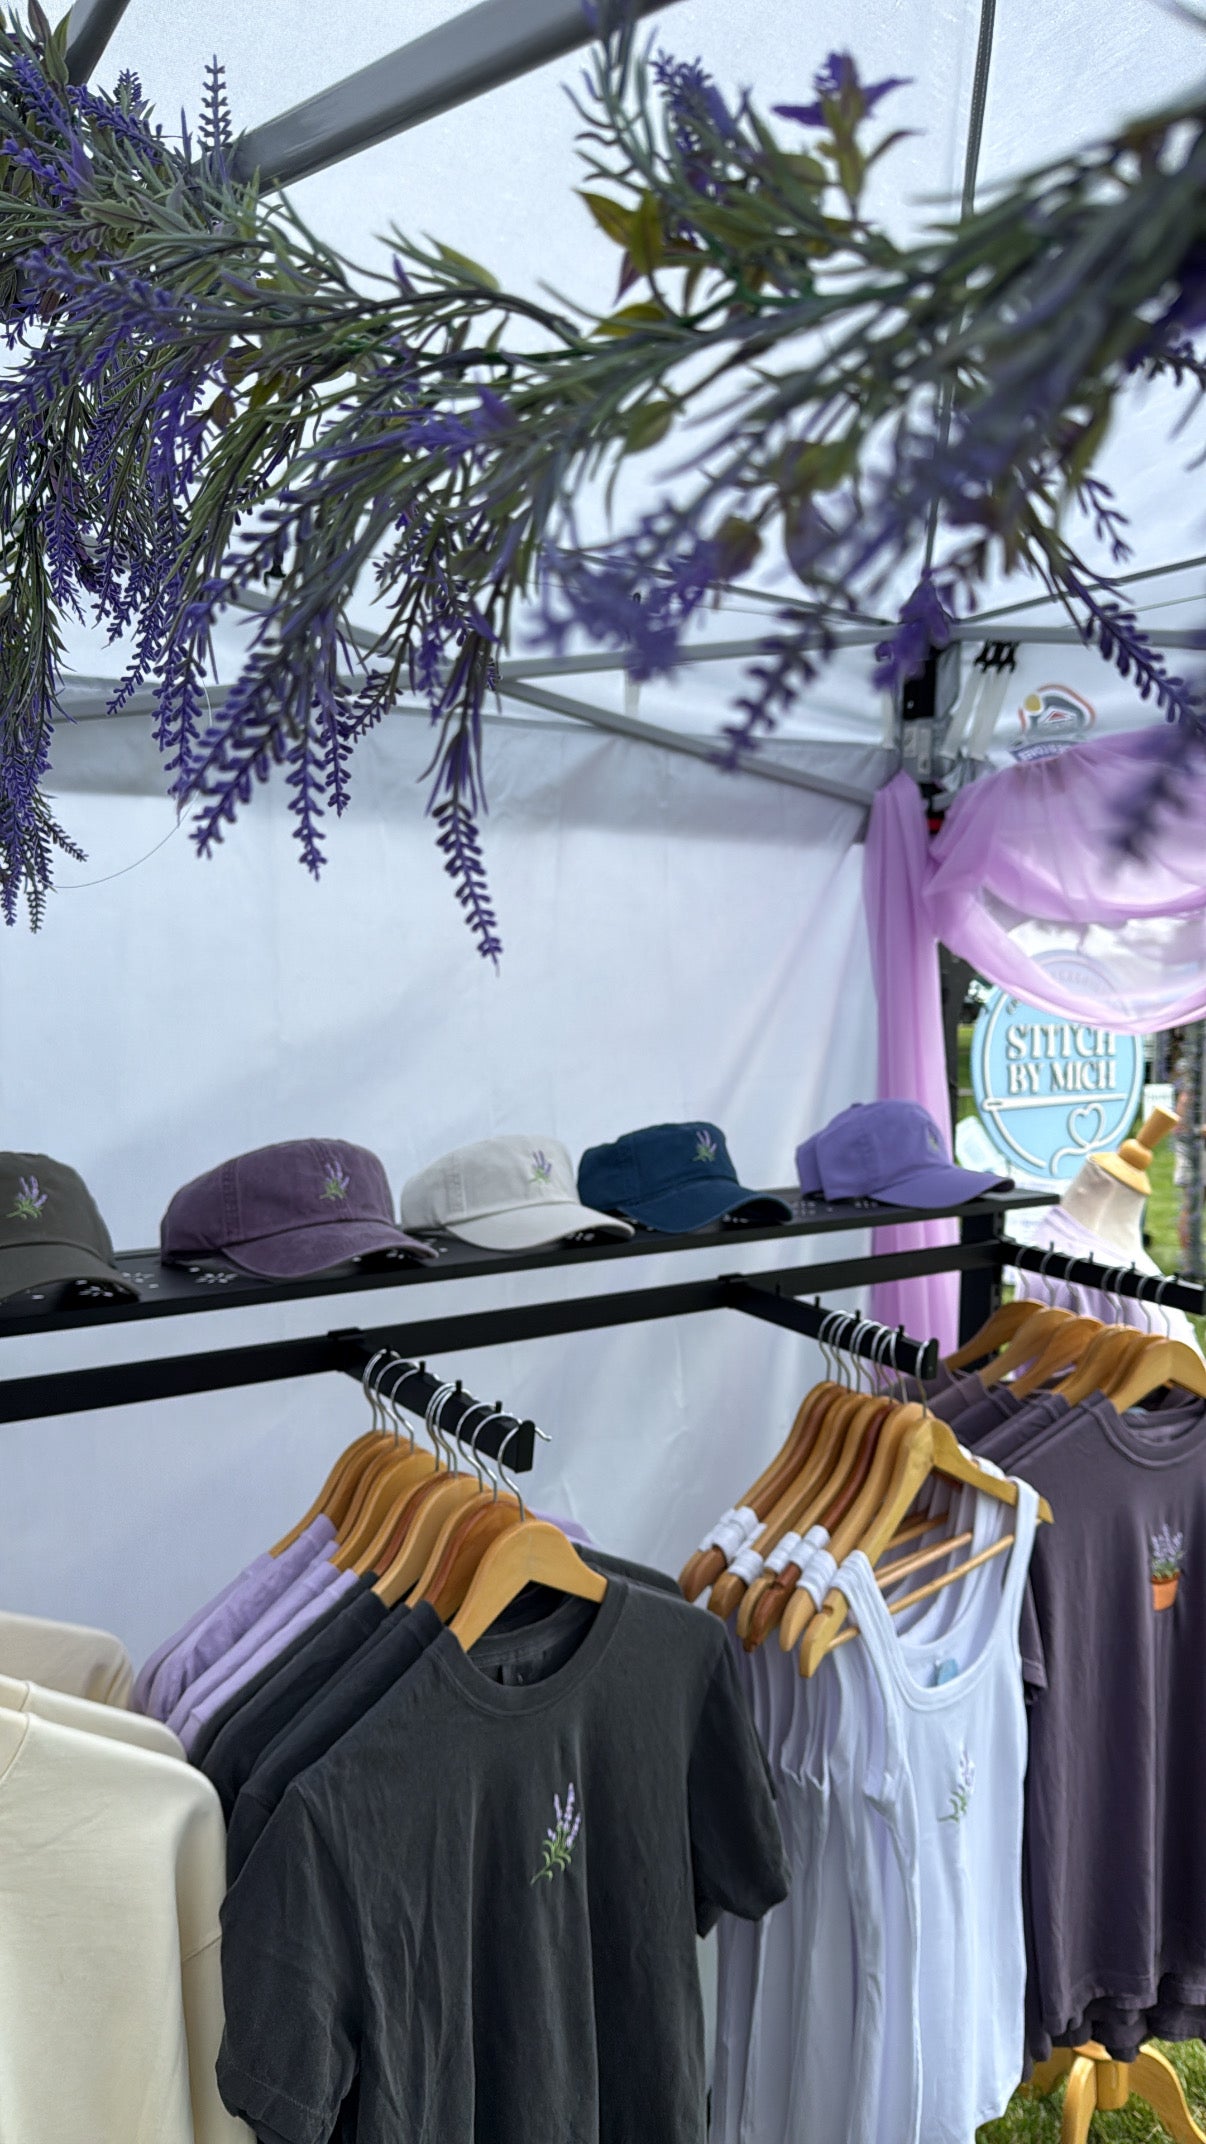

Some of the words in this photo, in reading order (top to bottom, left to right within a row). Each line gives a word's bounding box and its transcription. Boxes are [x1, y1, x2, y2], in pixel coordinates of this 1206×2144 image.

[1006, 1023, 1116, 1060] STITCH
[1008, 1062, 1042, 1095] BY
[1049, 1060, 1117, 1092] MICH
